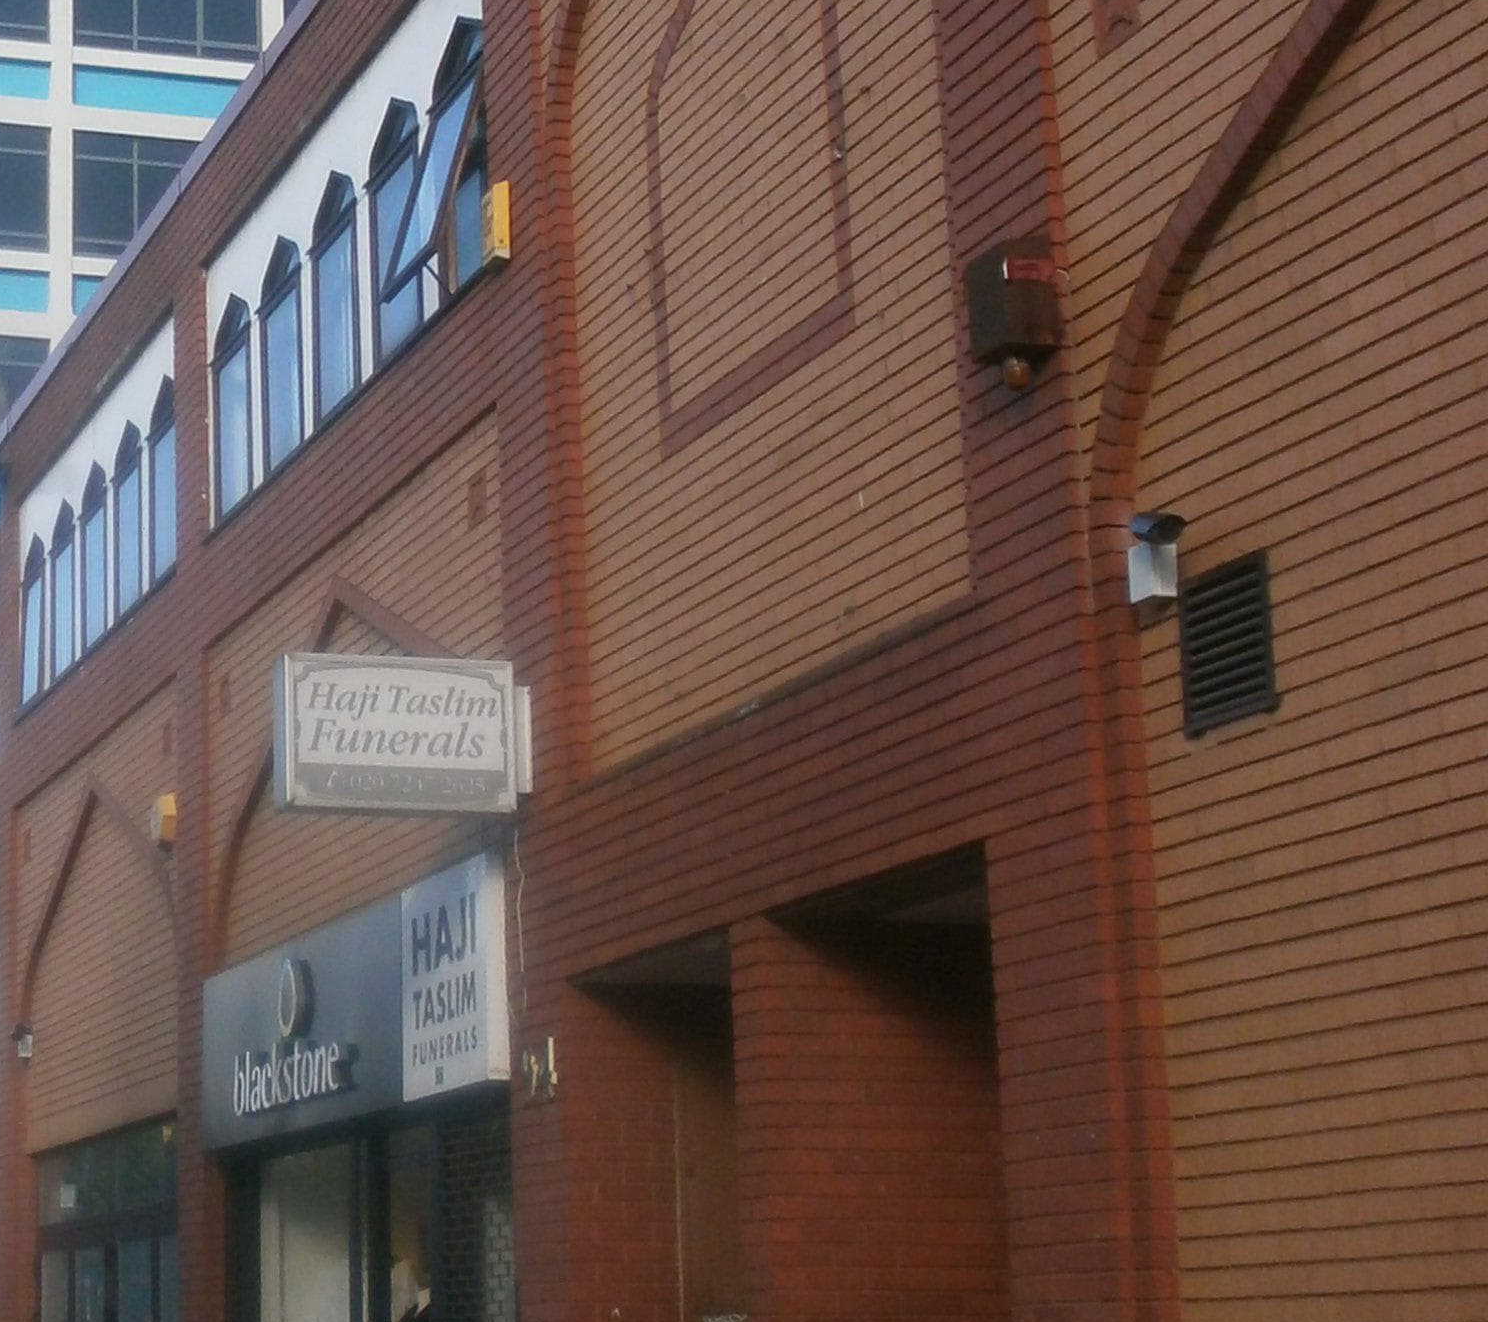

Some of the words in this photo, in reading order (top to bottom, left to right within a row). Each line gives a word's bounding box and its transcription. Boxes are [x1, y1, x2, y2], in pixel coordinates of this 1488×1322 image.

[305, 681, 381, 721] Haji
[388, 684, 498, 719] Taslim
[307, 717, 486, 759] Funerals
[411, 891, 477, 977] HAJI
[412, 969, 477, 1031] TASLIM
[411, 1024, 478, 1067] FUNERALS
[233, 1040, 340, 1117] blackstone
